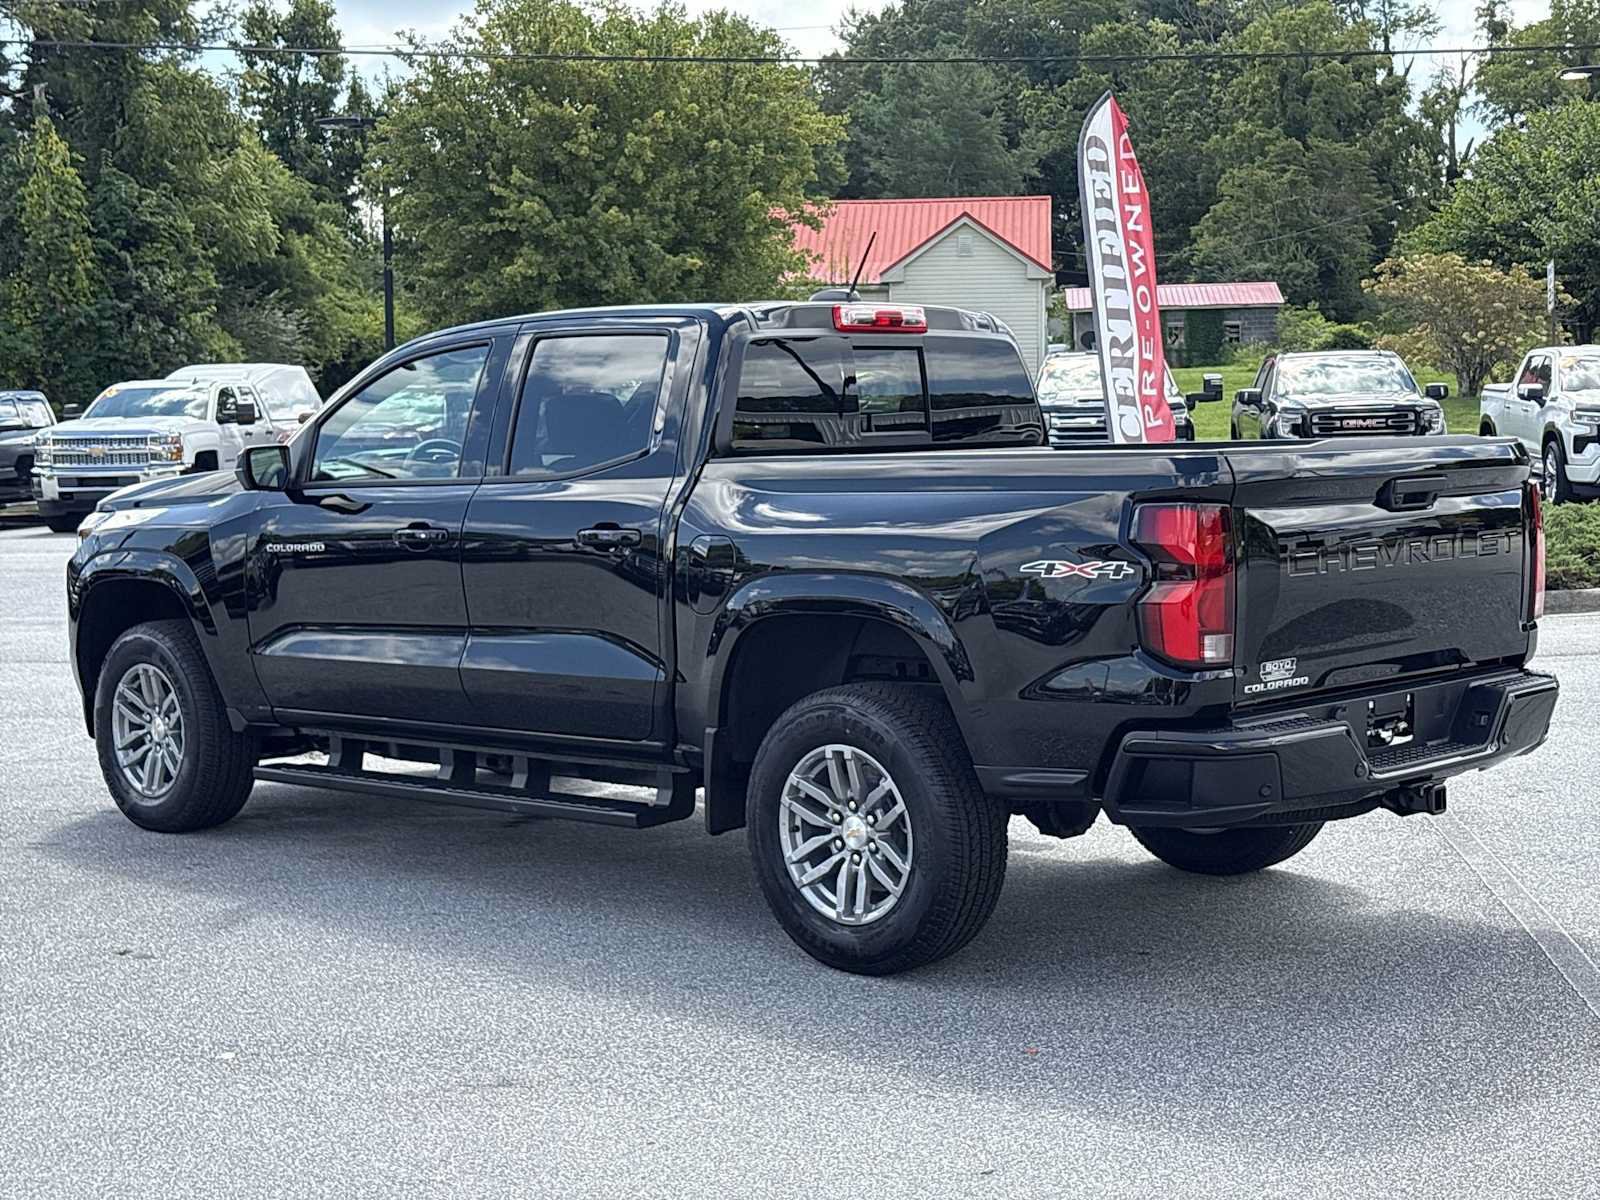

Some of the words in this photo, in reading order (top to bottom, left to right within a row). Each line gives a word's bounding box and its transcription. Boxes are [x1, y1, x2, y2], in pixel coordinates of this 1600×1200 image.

[1086, 135, 1143, 443] CERTIFIED
[1118, 133, 1163, 428] PRE-OWNED
[1342, 419, 1386, 428] GMC
[266, 543, 326, 553] COLORADO
[1286, 532, 1519, 577] CHEVROLET
[1265, 660, 1292, 672] BOYD
[1244, 676, 1309, 694] COLORADO
